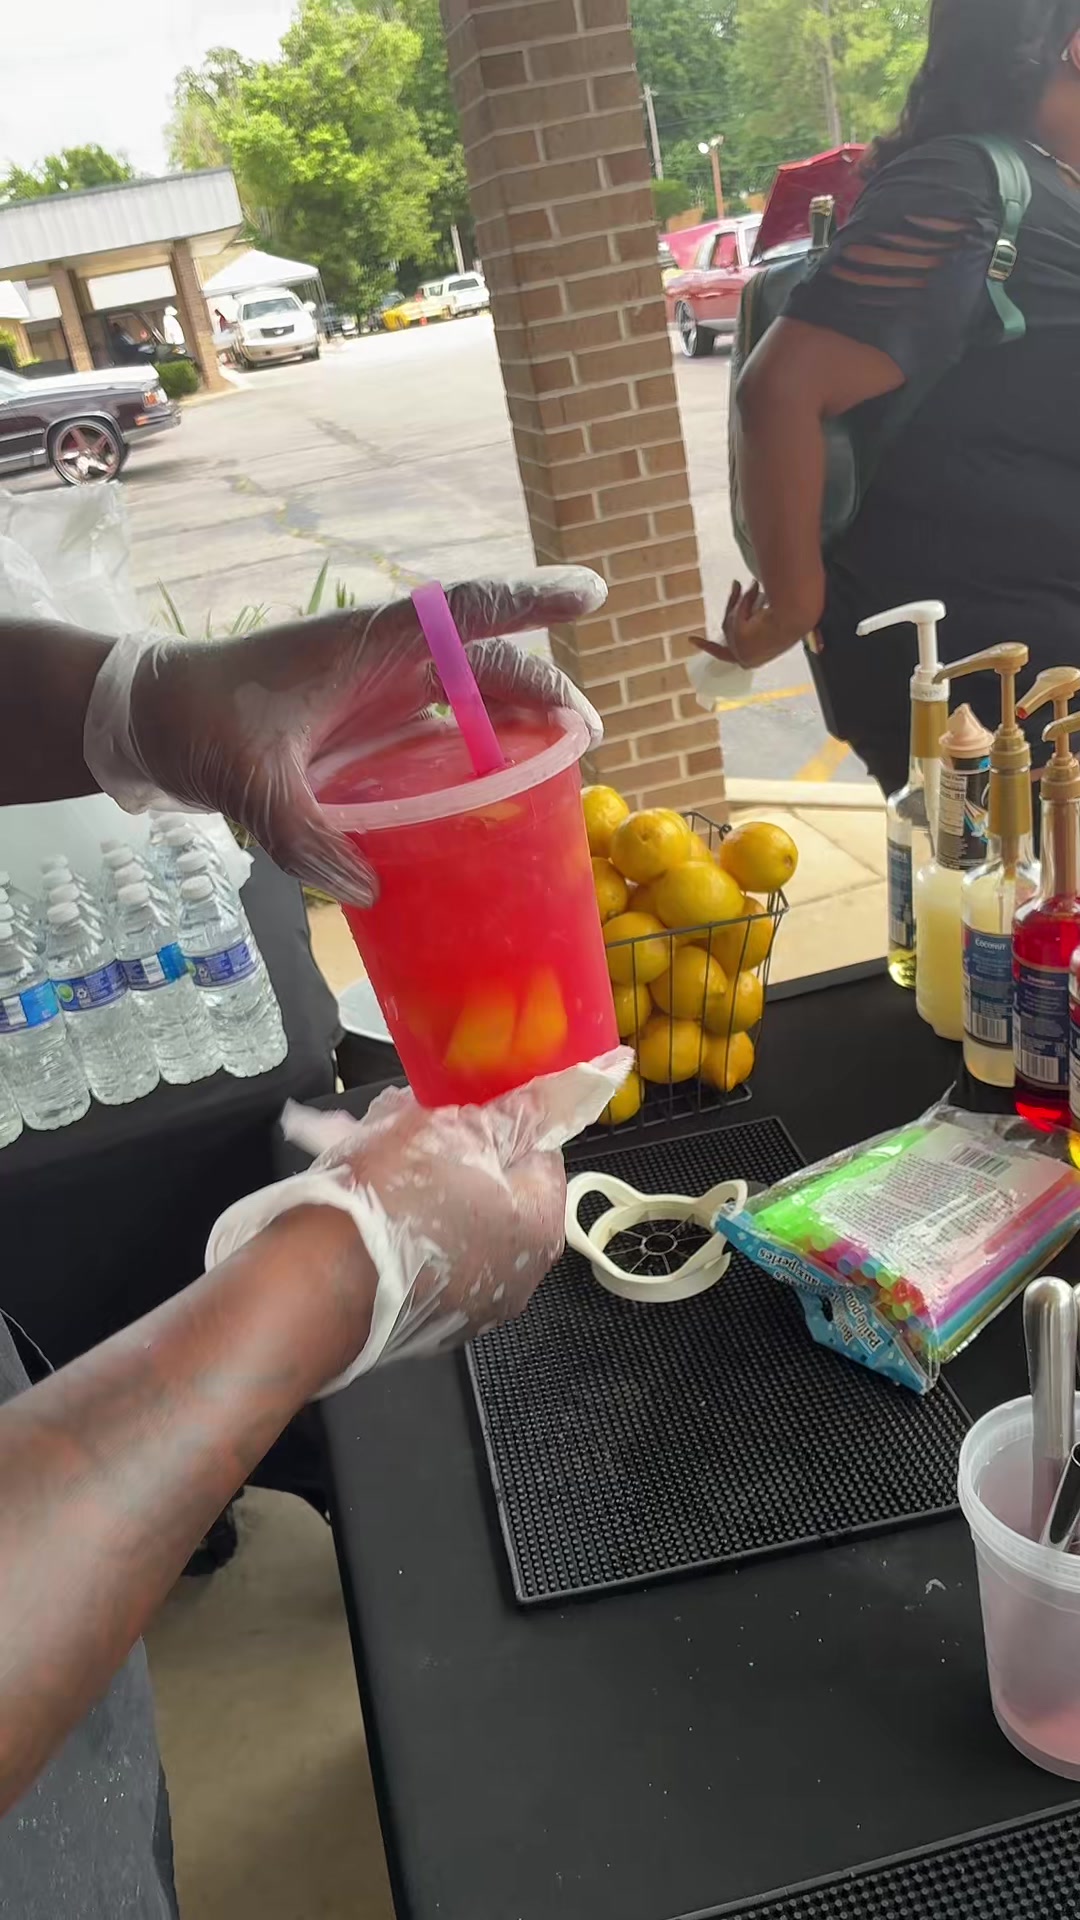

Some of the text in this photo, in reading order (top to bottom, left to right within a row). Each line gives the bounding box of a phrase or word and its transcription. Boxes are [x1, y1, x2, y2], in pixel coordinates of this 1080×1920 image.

[759, 1248, 797, 1272] perles
[797, 1266, 820, 1286] aux
[856, 1315, 882, 1351] Paille
